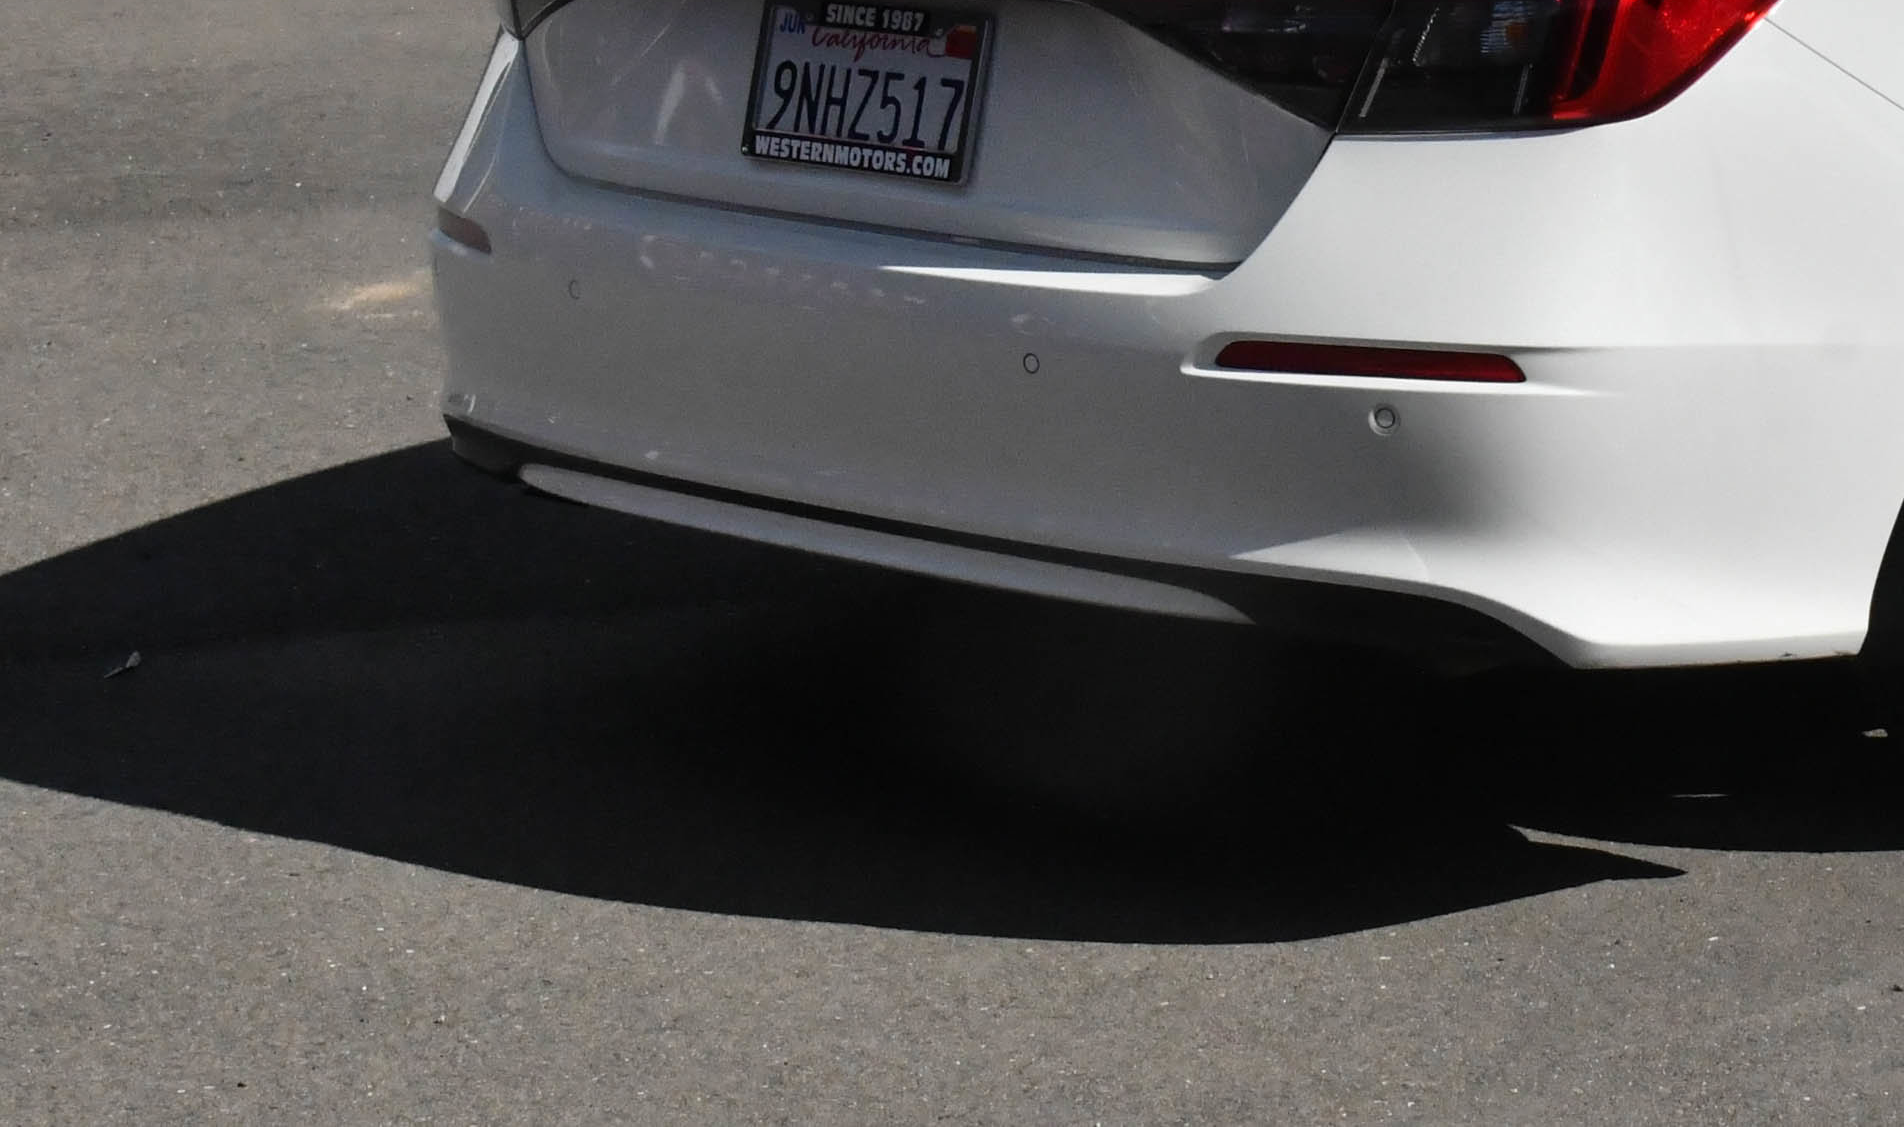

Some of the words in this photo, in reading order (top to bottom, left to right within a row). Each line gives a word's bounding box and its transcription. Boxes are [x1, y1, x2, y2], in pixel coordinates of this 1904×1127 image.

[825, 3, 877, 28] SINCE
[882, 9, 925, 33] 1987
[811, 25, 947, 63] California
[765, 59, 966, 151] 9NHZ517
[754, 135, 951, 179] WESTERNMOTORS.COM
